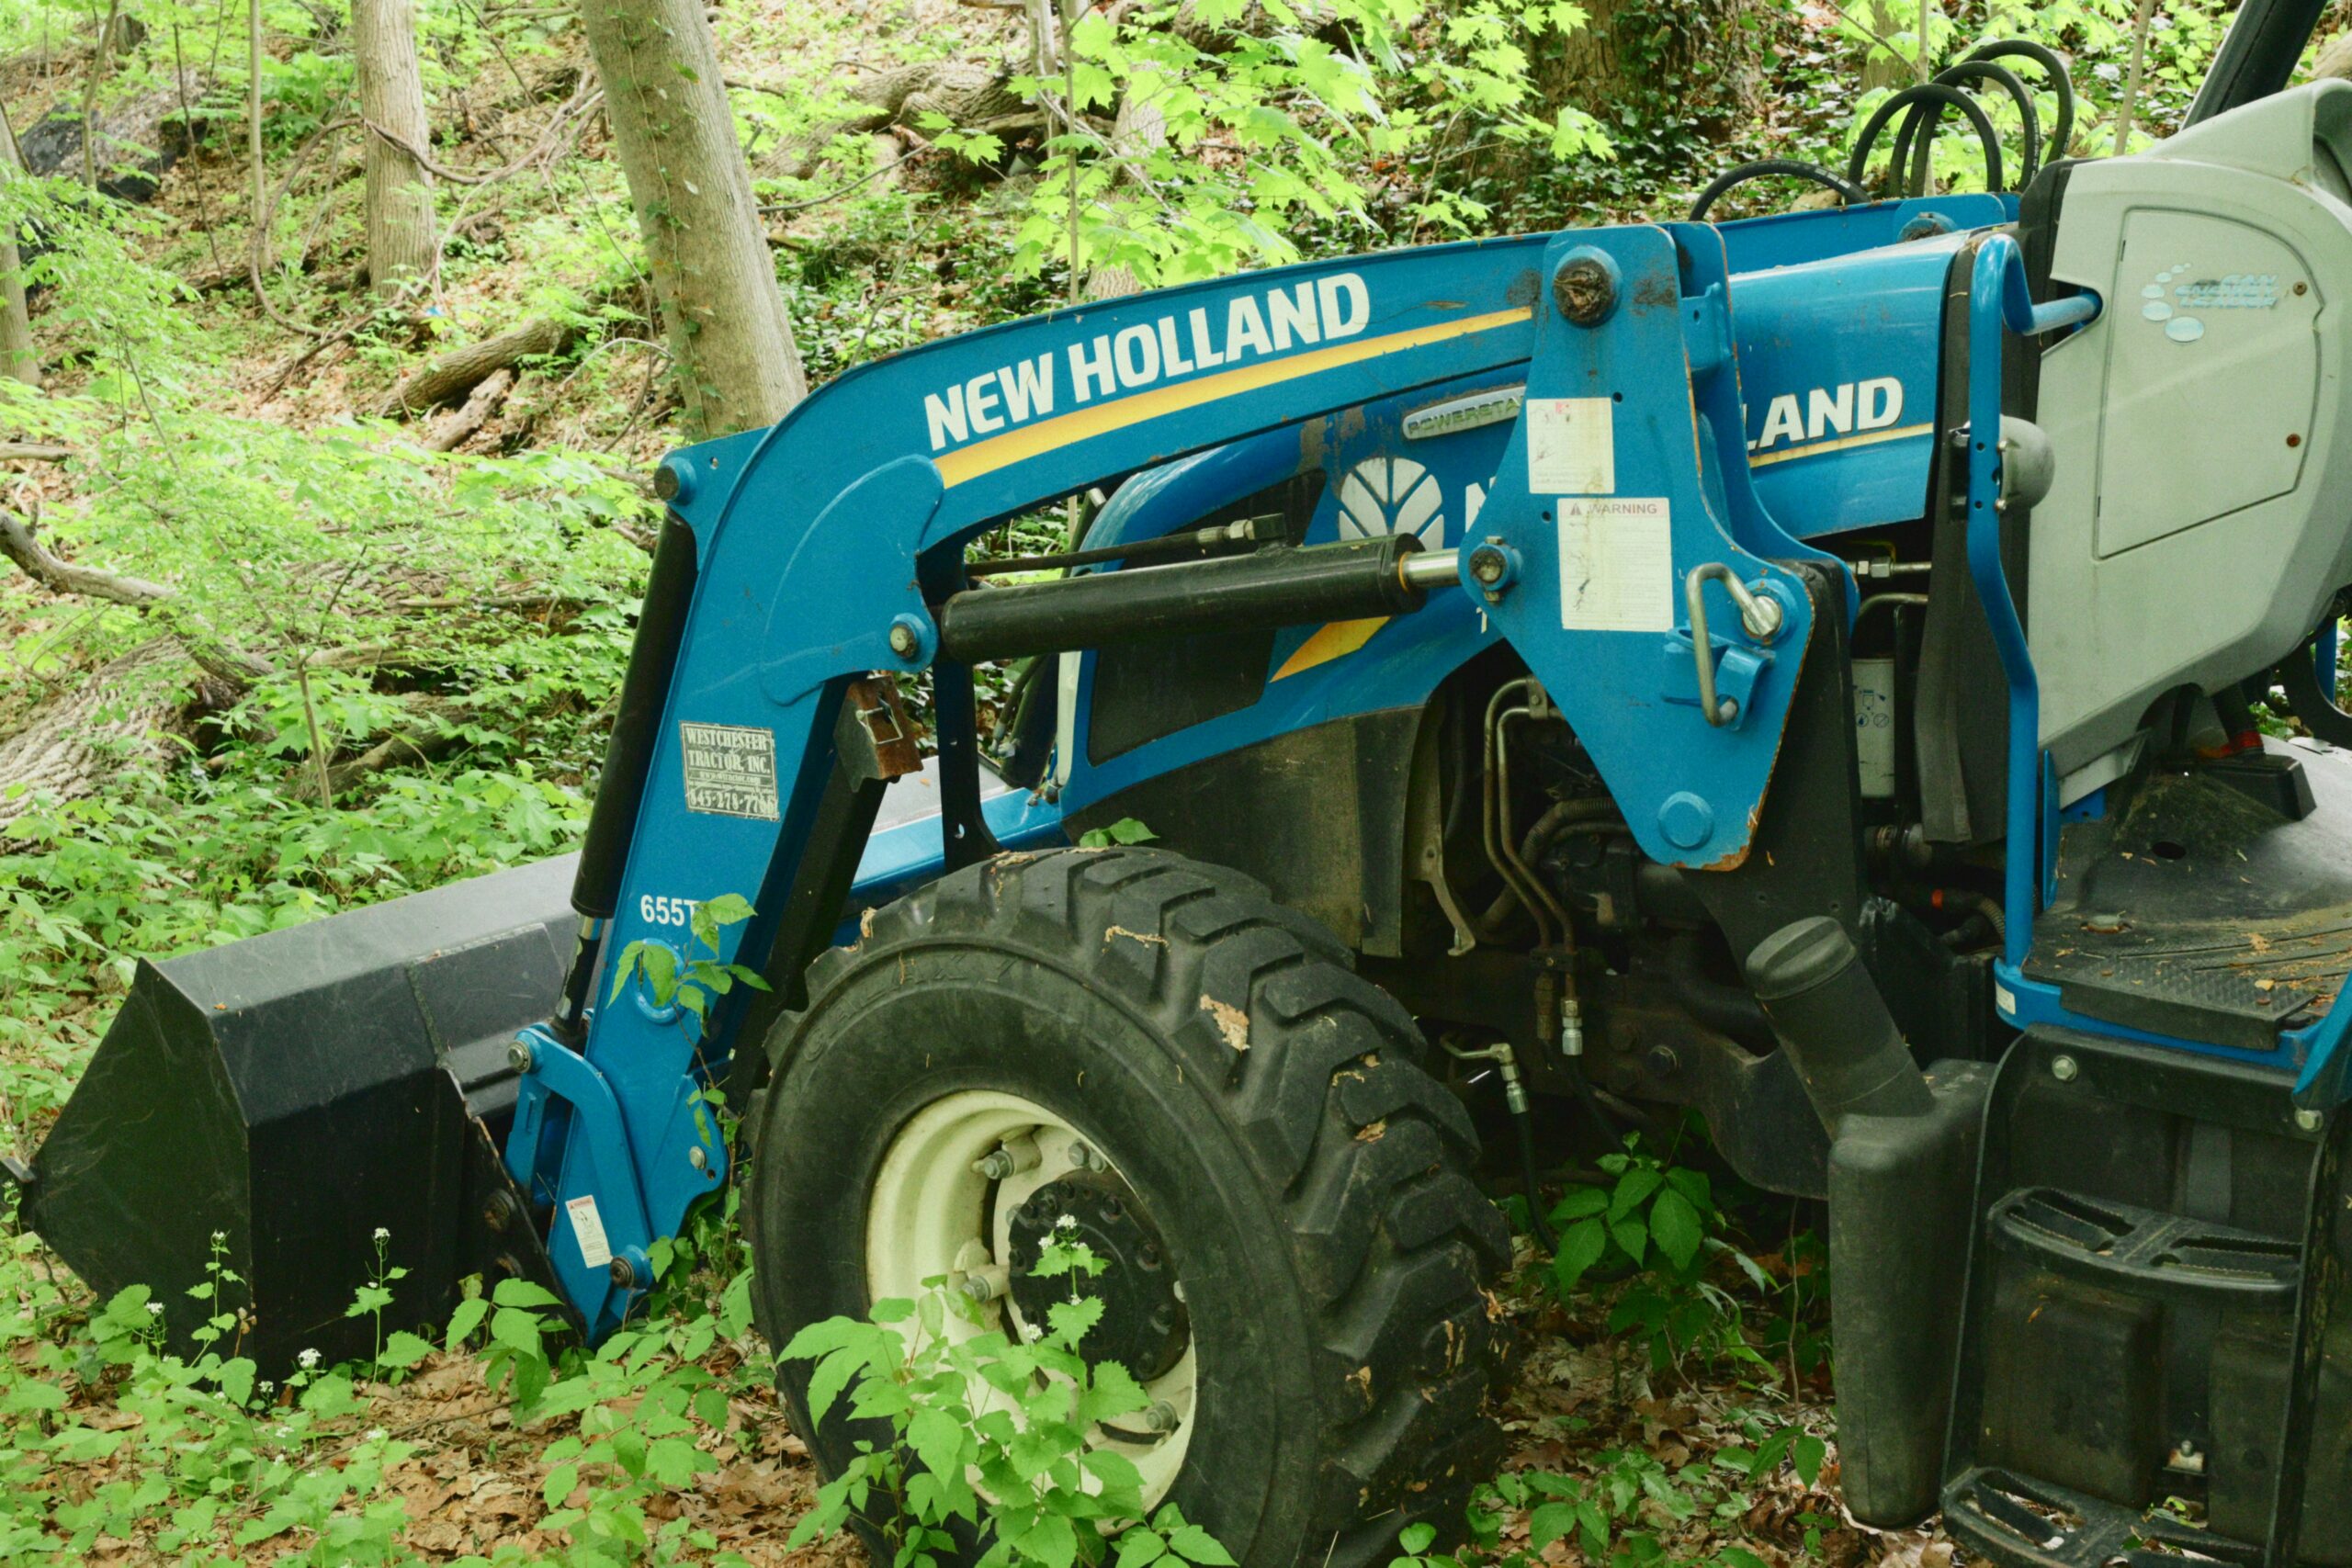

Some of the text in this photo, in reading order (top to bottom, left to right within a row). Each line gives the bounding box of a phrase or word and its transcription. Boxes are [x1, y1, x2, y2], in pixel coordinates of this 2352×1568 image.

[924, 272, 1371, 451] NEW HOLLAND
[1408, 394, 1523, 434] POWERSTA
[1589, 503, 1657, 514] WARNING
[686, 727, 767, 751] WESTCHESTER
[747, 755, 771, 774] INC.
[640, 894, 718, 930] 655T
